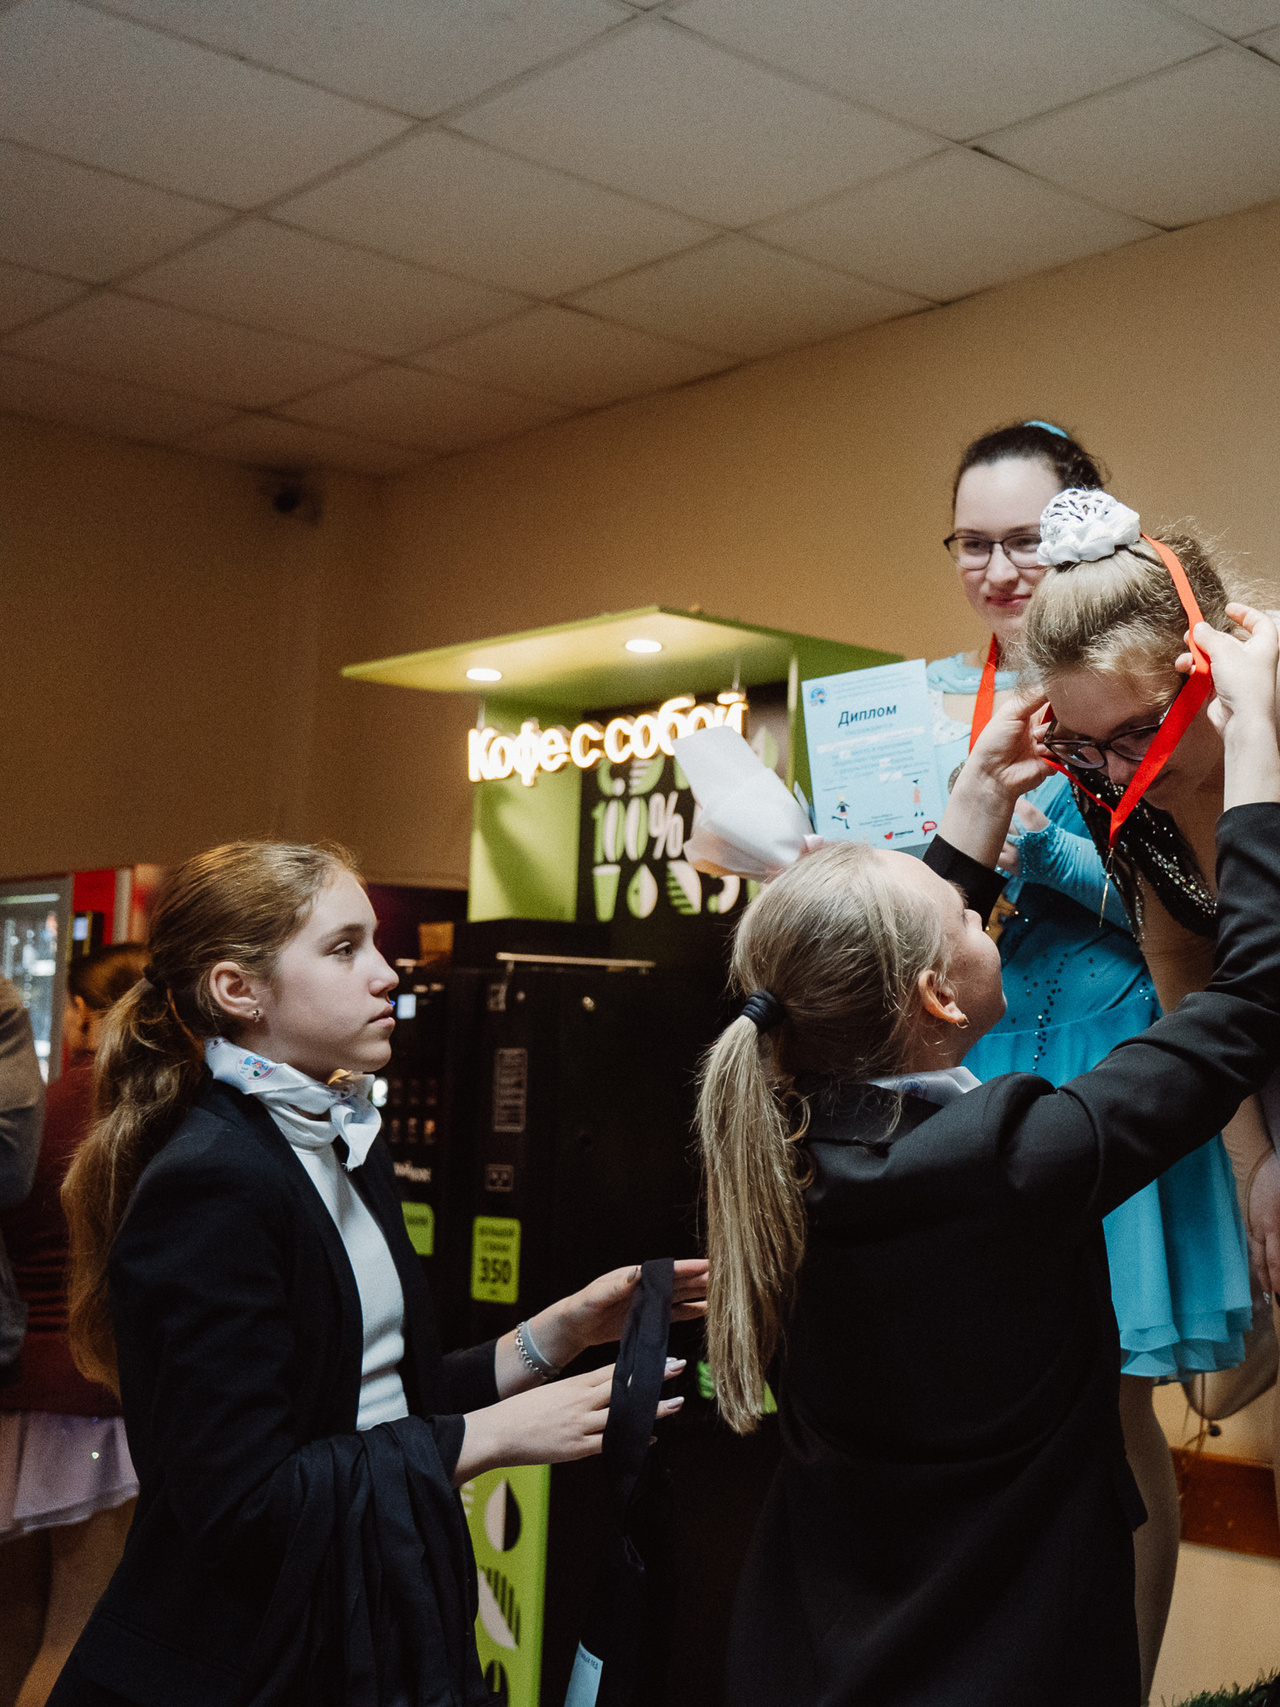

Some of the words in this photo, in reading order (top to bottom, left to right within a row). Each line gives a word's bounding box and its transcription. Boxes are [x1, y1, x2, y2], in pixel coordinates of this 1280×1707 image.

[838, 704, 897, 728] Диплом
[467, 718, 568, 787] Кофе
[592, 790, 684, 864] 100%
[479, 1257, 512, 1284] 350
